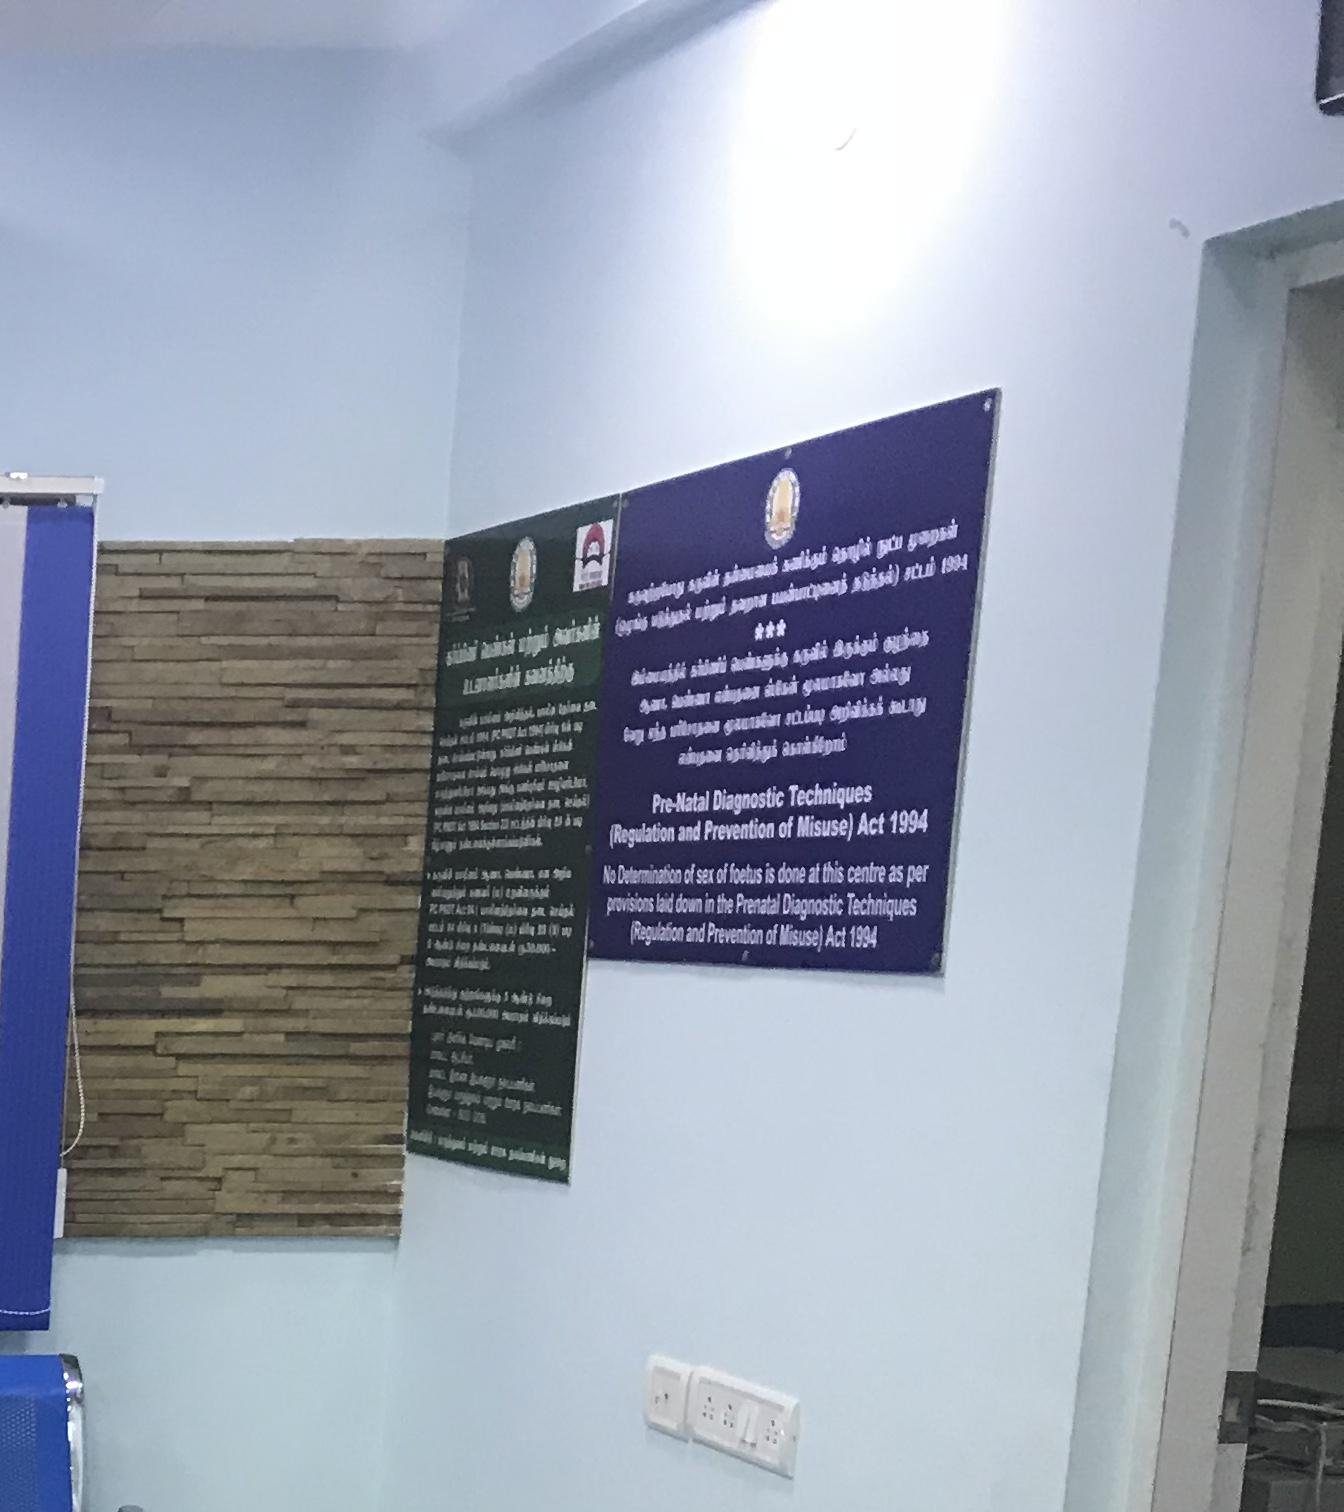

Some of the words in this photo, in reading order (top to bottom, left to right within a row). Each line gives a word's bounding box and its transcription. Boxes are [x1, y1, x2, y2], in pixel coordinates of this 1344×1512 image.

[941, 553, 968, 574] 1994
[652, 790, 710, 814] Pre-Natal
[713, 786, 784, 815] Diagnostic
[788, 782, 872, 809] Techniques
[610, 822, 675, 849] (Regulation
[678, 820, 701, 841] and
[704, 818, 774, 840] Prevention
[778, 816, 793, 838] of
[797, 812, 853, 841] Misuse)
[857, 812, 884, 835] Act
[890, 809, 928, 833] 1994
[603, 864, 616, 884] No
[618, 864, 681, 884] Determination
[684, 863, 695, 884] of
[696, 867, 714, 884] sex
[717, 863, 728, 884] of
[729, 863, 762, 884] foetus
[765, 863, 775, 883] is
[778, 862, 806, 883] done
[808, 863, 819, 883] at
[823, 860, 844, 883] this
[847, 862, 886, 883] centre
[888, 864, 903, 883] as
[907, 864, 929, 888] per
[607, 892, 654, 916] provisions
[657, 893, 674, 913] laid
[676, 893, 702, 913] down
[704, 893, 715, 914] in
[717, 893, 734, 914] the
[736, 893, 780, 915] Prenatal
[782, 893, 843, 921] Diagnostic
[847, 892, 917, 921] Techniques
[631, 920, 684, 946] (Regulation
[686, 922, 706, 943] and
[707, 922, 763, 944] Prevention
[766, 923, 778, 945] of
[779, 924, 823, 952] Misuse)
[825, 925, 846, 948] Act
[850, 925, 877, 948] 1994
